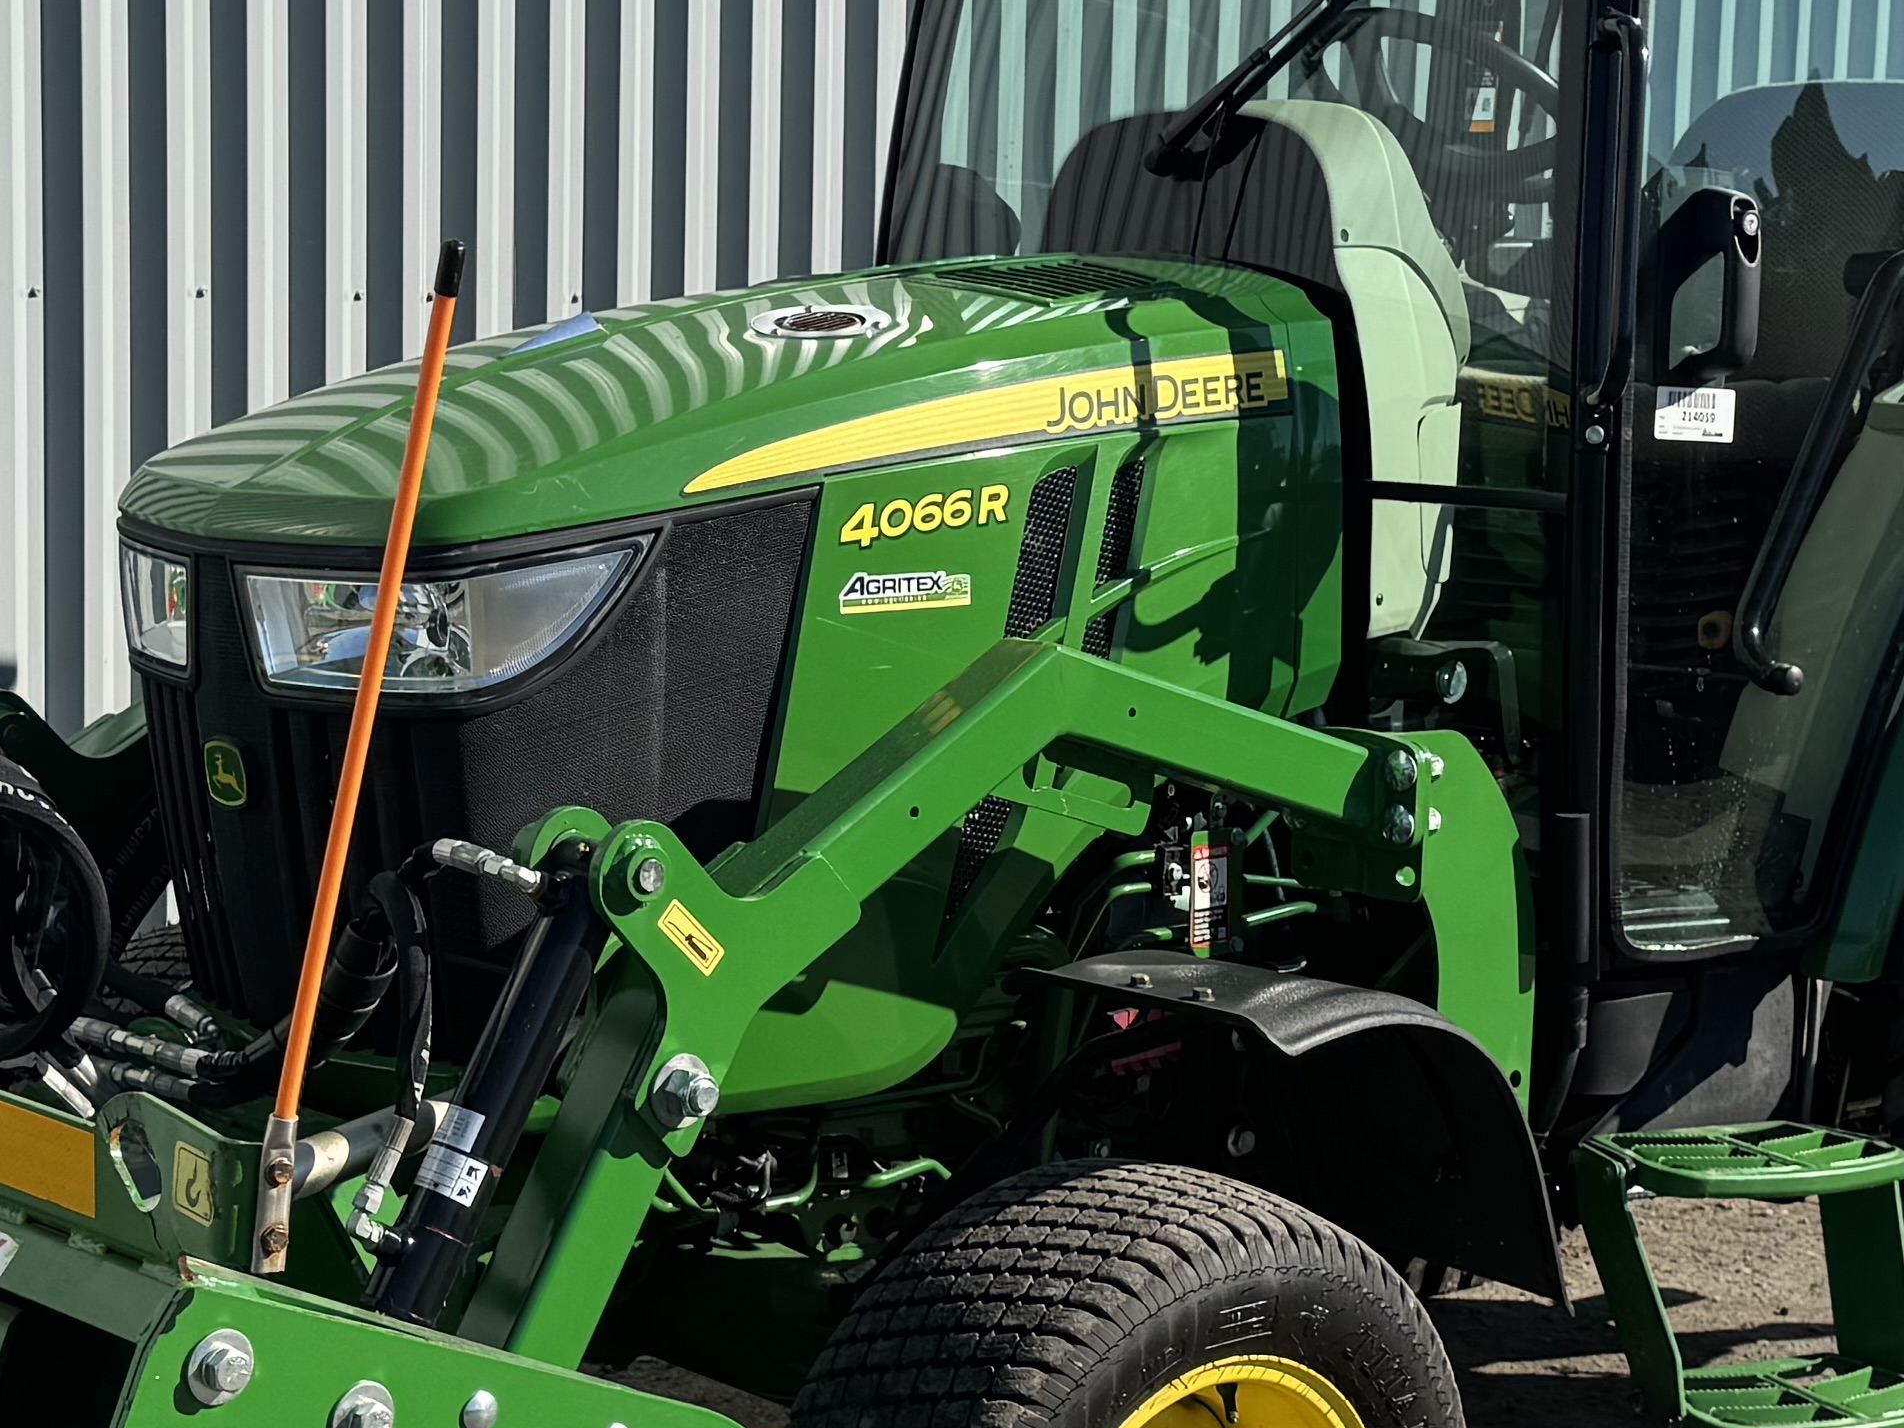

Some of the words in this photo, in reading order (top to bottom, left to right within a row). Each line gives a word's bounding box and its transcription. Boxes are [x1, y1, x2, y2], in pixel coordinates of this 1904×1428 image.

[1046, 383, 1146, 427] JOHN
[1153, 371, 1266, 413] DEERE
[840, 484, 1009, 548] 4066R
[843, 575, 943, 597] AGRITEX
